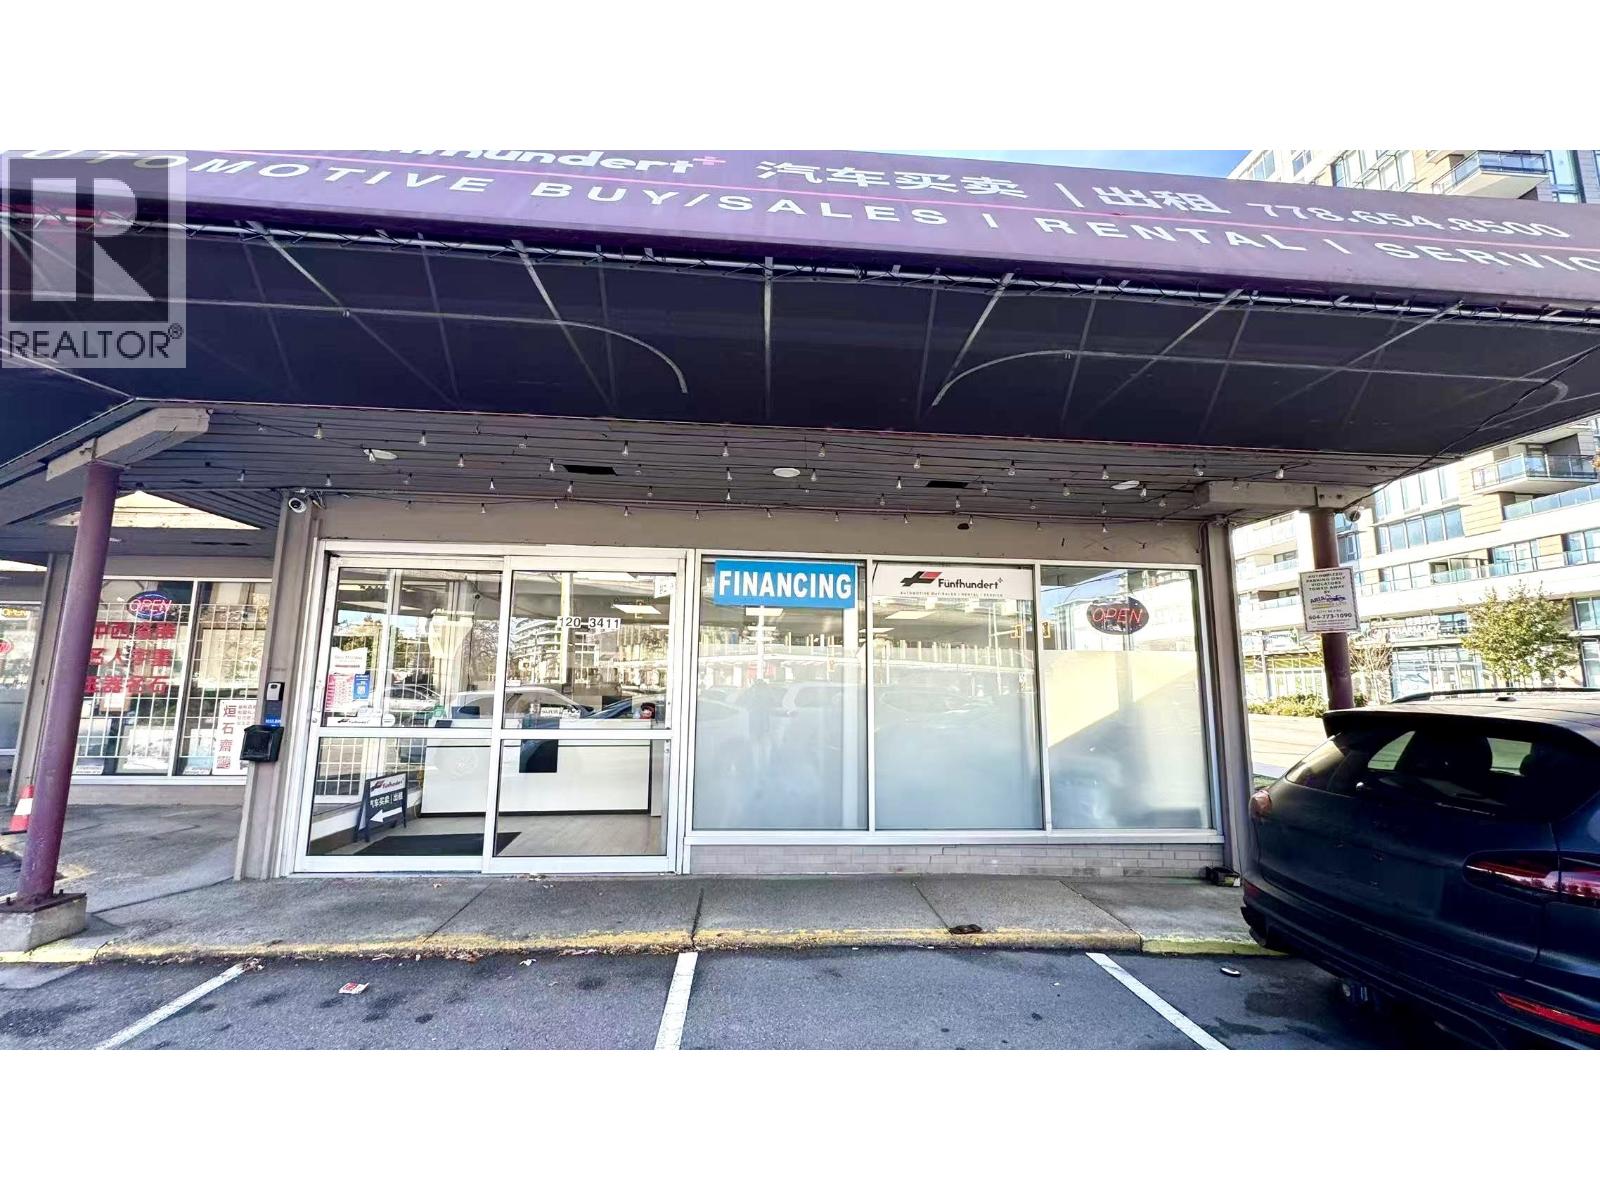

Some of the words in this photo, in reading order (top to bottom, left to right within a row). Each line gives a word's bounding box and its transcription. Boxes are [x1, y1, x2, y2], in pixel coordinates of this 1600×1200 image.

[756, 161, 1029, 198] 汽车买卖
[1091, 186, 1231, 214] 出租
[530, 182, 949, 225] BUY/SALES
[1033, 217, 1307, 251] RENTAL
[1246, 203, 1571, 238] 778.654.8500
[719, 570, 851, 599] FINANCING
[130, 599, 172, 612] OPEN
[1092, 607, 1143, 624] OPEN
